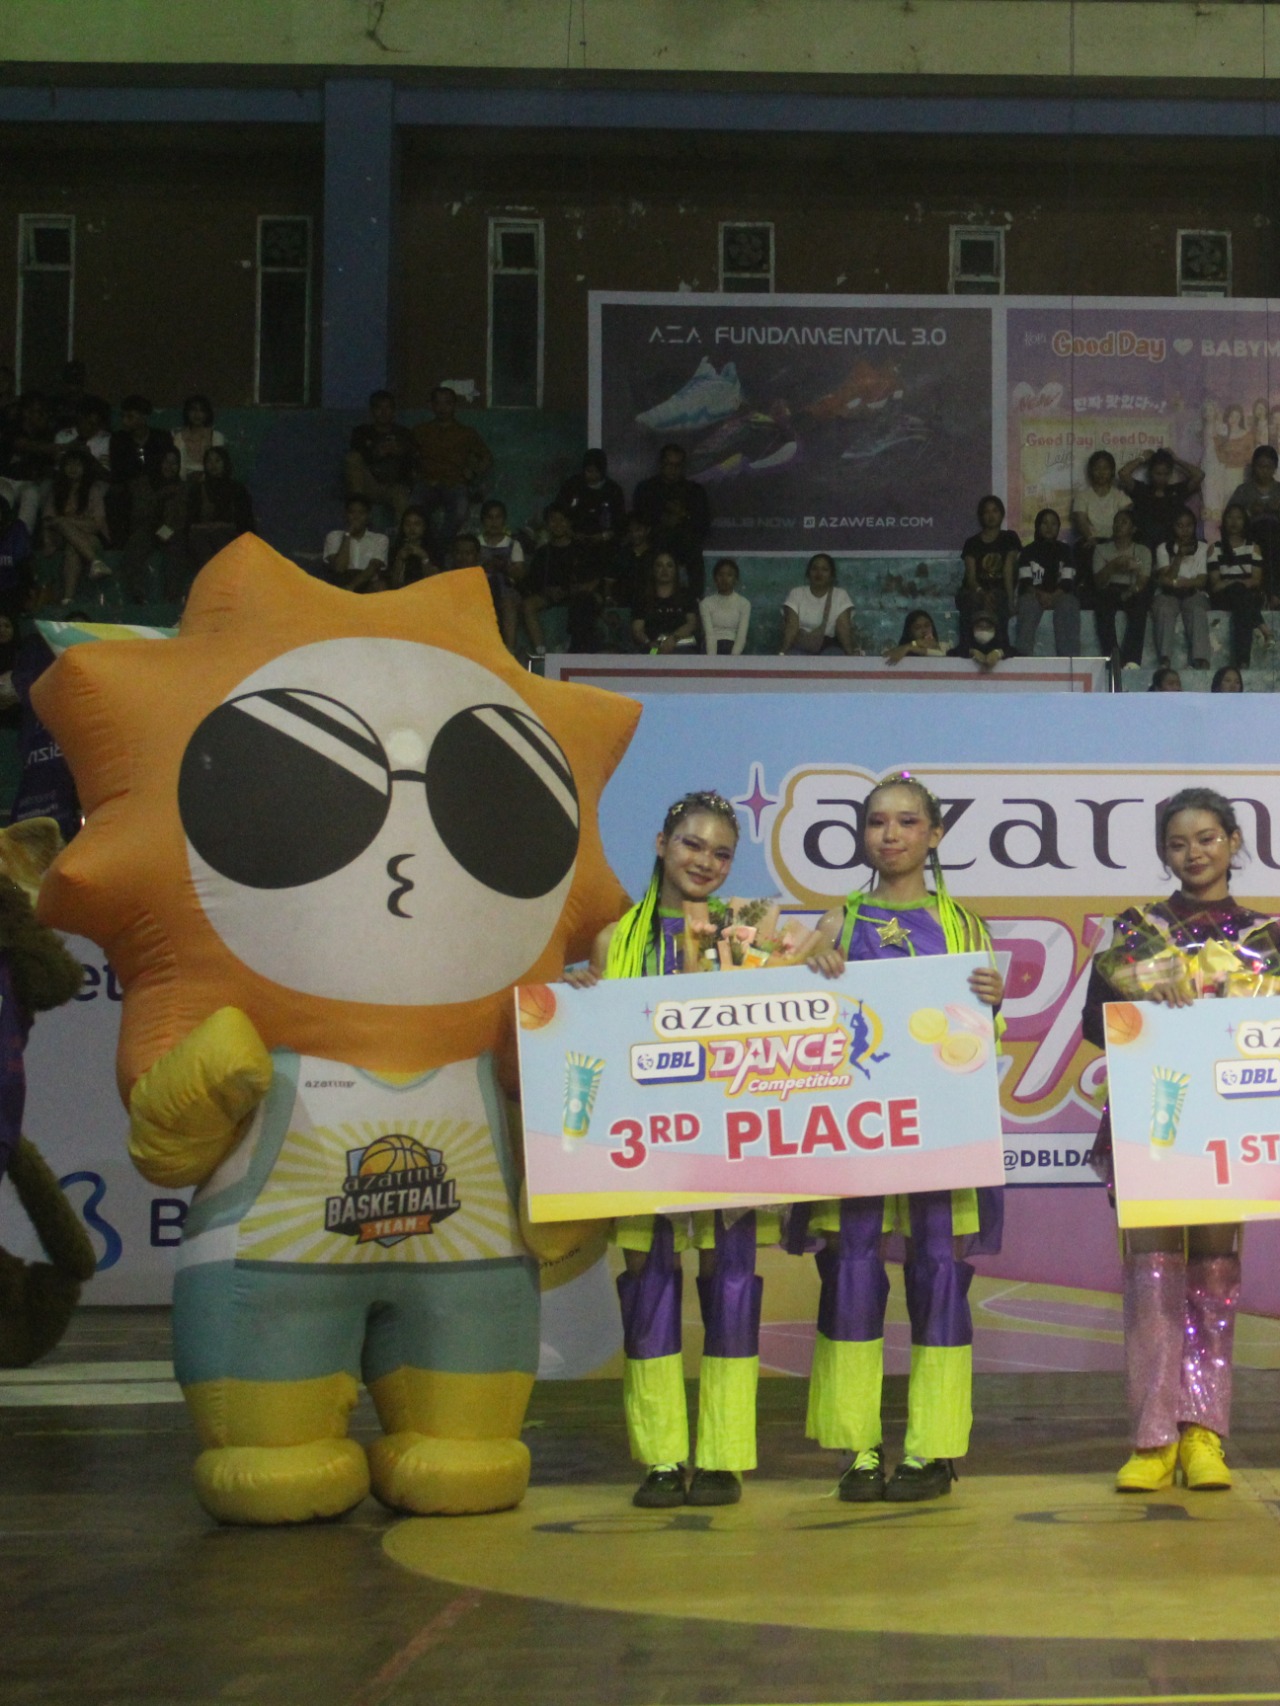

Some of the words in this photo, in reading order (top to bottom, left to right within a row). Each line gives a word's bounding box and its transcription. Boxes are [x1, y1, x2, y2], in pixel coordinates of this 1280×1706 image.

[715, 327, 906, 345] FUNDAMENTAL
[912, 328, 948, 345] 3.0
[655, 1051, 694, 1069] DBL
[708, 1029, 849, 1094] DANCE
[747, 1074, 850, 1098] Competition
[1239, 1067, 1277, 1085] DBL
[725, 1099, 919, 1160] PLACE
[328, 1179, 459, 1228] BASKETBALL
[374, 1219, 417, 1235] TEAM
